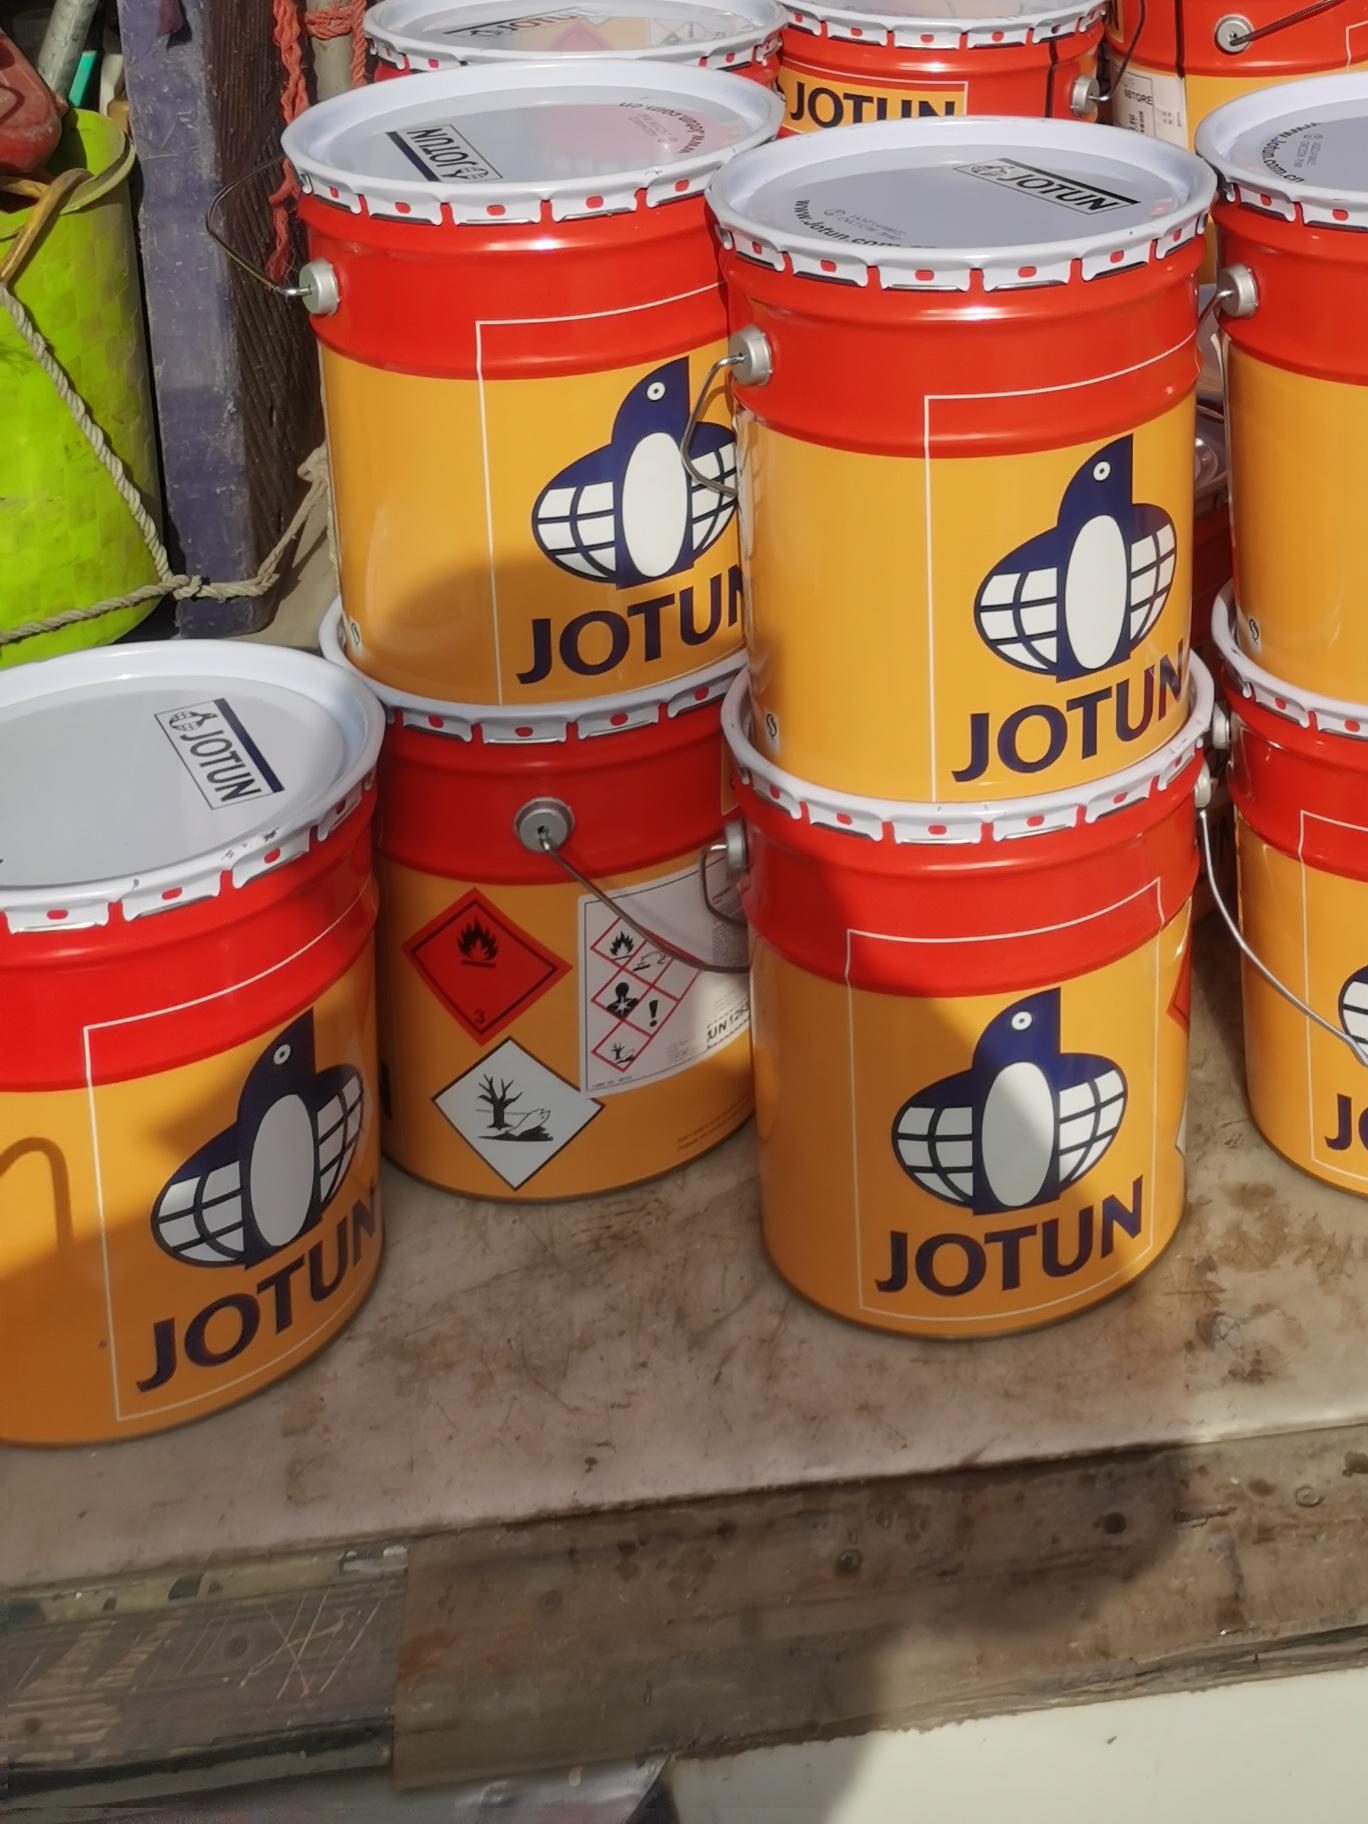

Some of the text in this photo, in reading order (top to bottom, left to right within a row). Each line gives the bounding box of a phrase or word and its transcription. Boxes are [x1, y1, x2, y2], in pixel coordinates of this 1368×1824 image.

[406, 127, 470, 179] JOTUN
[1000, 170, 1121, 213] JOTUN
[952, 639, 1184, 782] JOTUN
[181, 735, 260, 801] JOTUN
[474, 1009, 486, 1026] 3
[876, 1177, 1142, 1297] JOTUN
[137, 1181, 376, 1392] JOTUN
